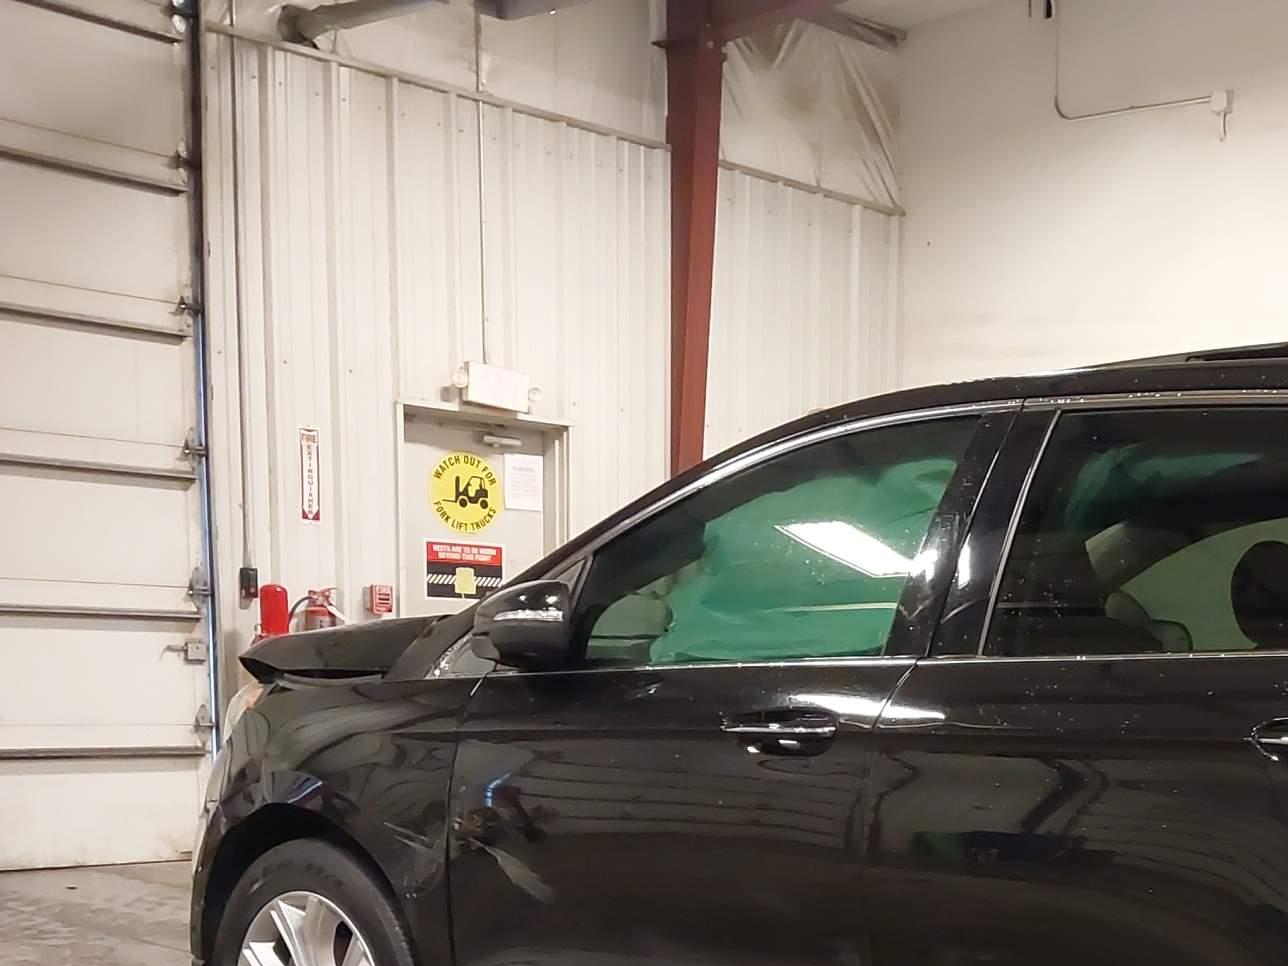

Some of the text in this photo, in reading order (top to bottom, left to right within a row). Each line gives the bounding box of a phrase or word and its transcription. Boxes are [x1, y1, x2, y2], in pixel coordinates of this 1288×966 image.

[433, 455, 461, 479] WATCH
[463, 455, 481, 468] OUT
[481, 466, 497, 486] FOR
[433, 501, 497, 531] FORK LIFT TRUCKS
